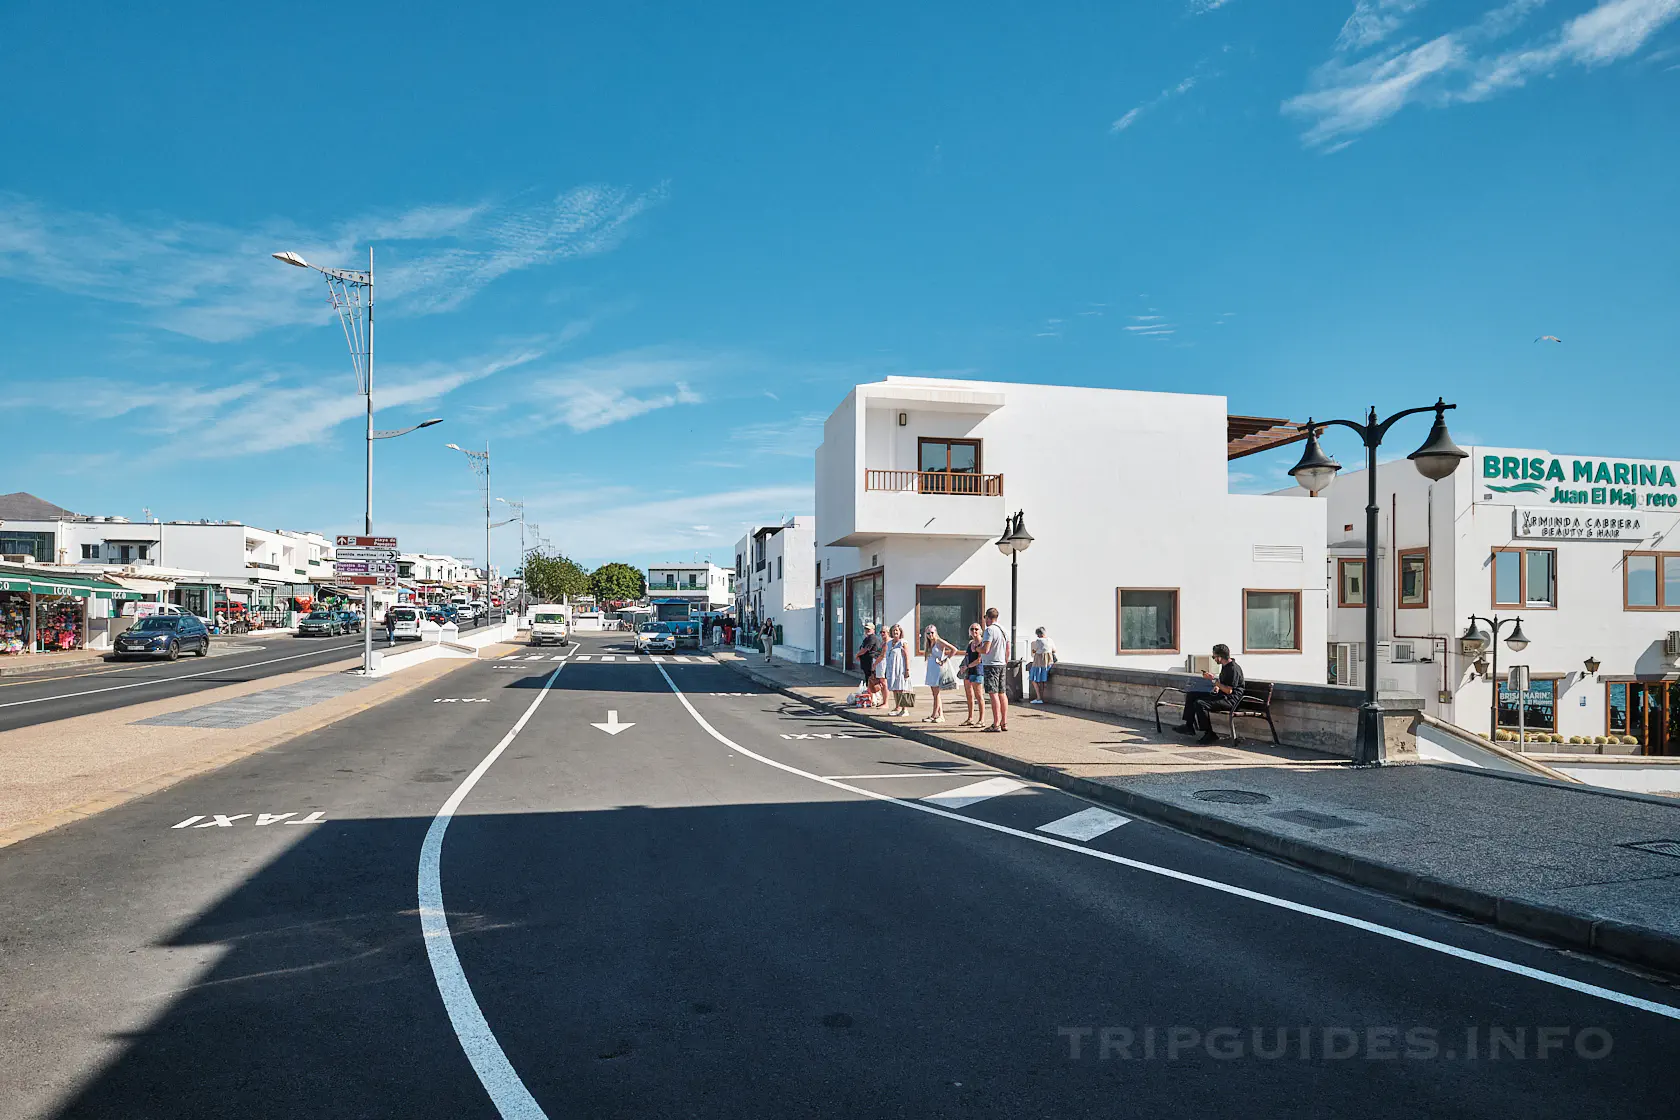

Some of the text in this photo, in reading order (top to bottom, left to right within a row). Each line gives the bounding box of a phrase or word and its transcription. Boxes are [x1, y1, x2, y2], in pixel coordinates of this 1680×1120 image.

[1483, 455, 1677, 487] BRISA MARINA
[1550, 486, 1588, 506] Juan
[1591, 487, 1606, 505] El
[1585, 518, 1641, 530] CABRERA
[1541, 527, 1584, 537] BEAUTY
[1596, 529, 1620, 538] HAIR
[53, 587, 73, 596] ICCO
[111, 592, 127, 600] ICCO
[170, 811, 328, 829] TAXI
